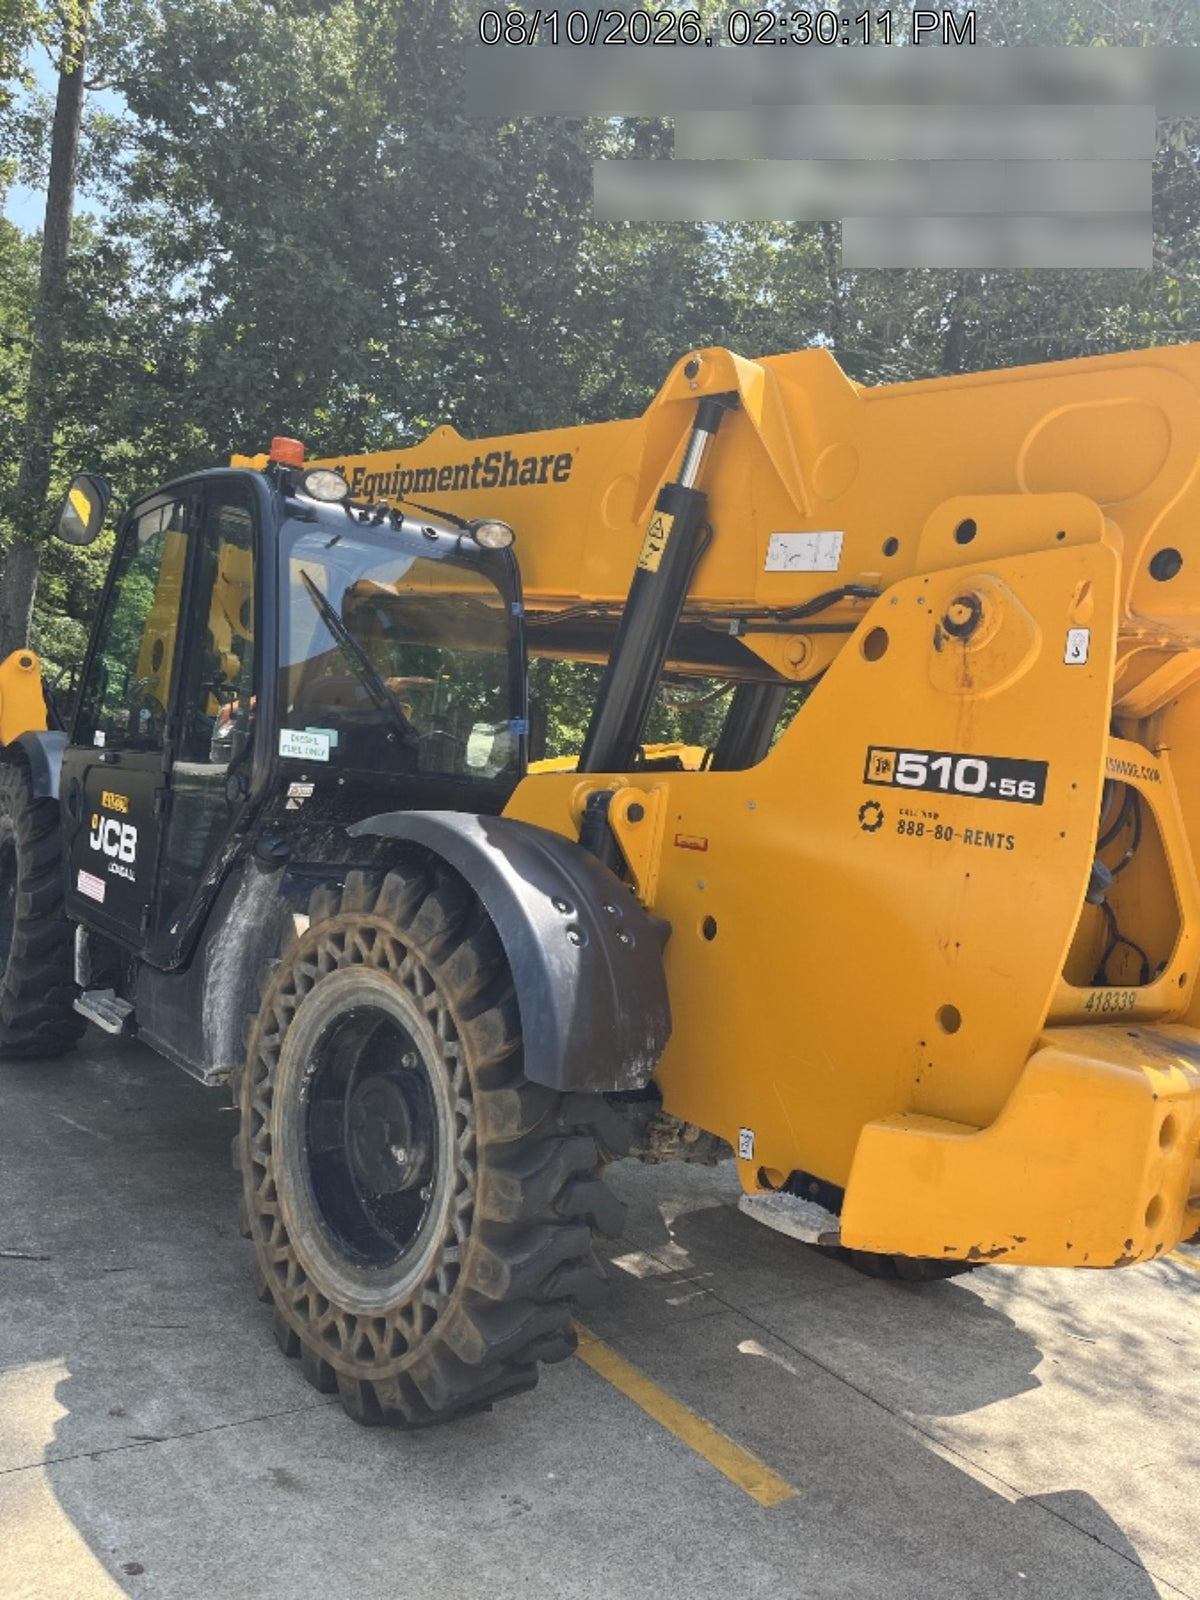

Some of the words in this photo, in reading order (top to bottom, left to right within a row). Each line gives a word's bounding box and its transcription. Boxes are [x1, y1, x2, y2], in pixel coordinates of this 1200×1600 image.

[350, 451, 573, 503] EquipmentShare
[89, 816, 137, 863] JCB
[897, 819, 1015, 851] 888-80-RENTS
